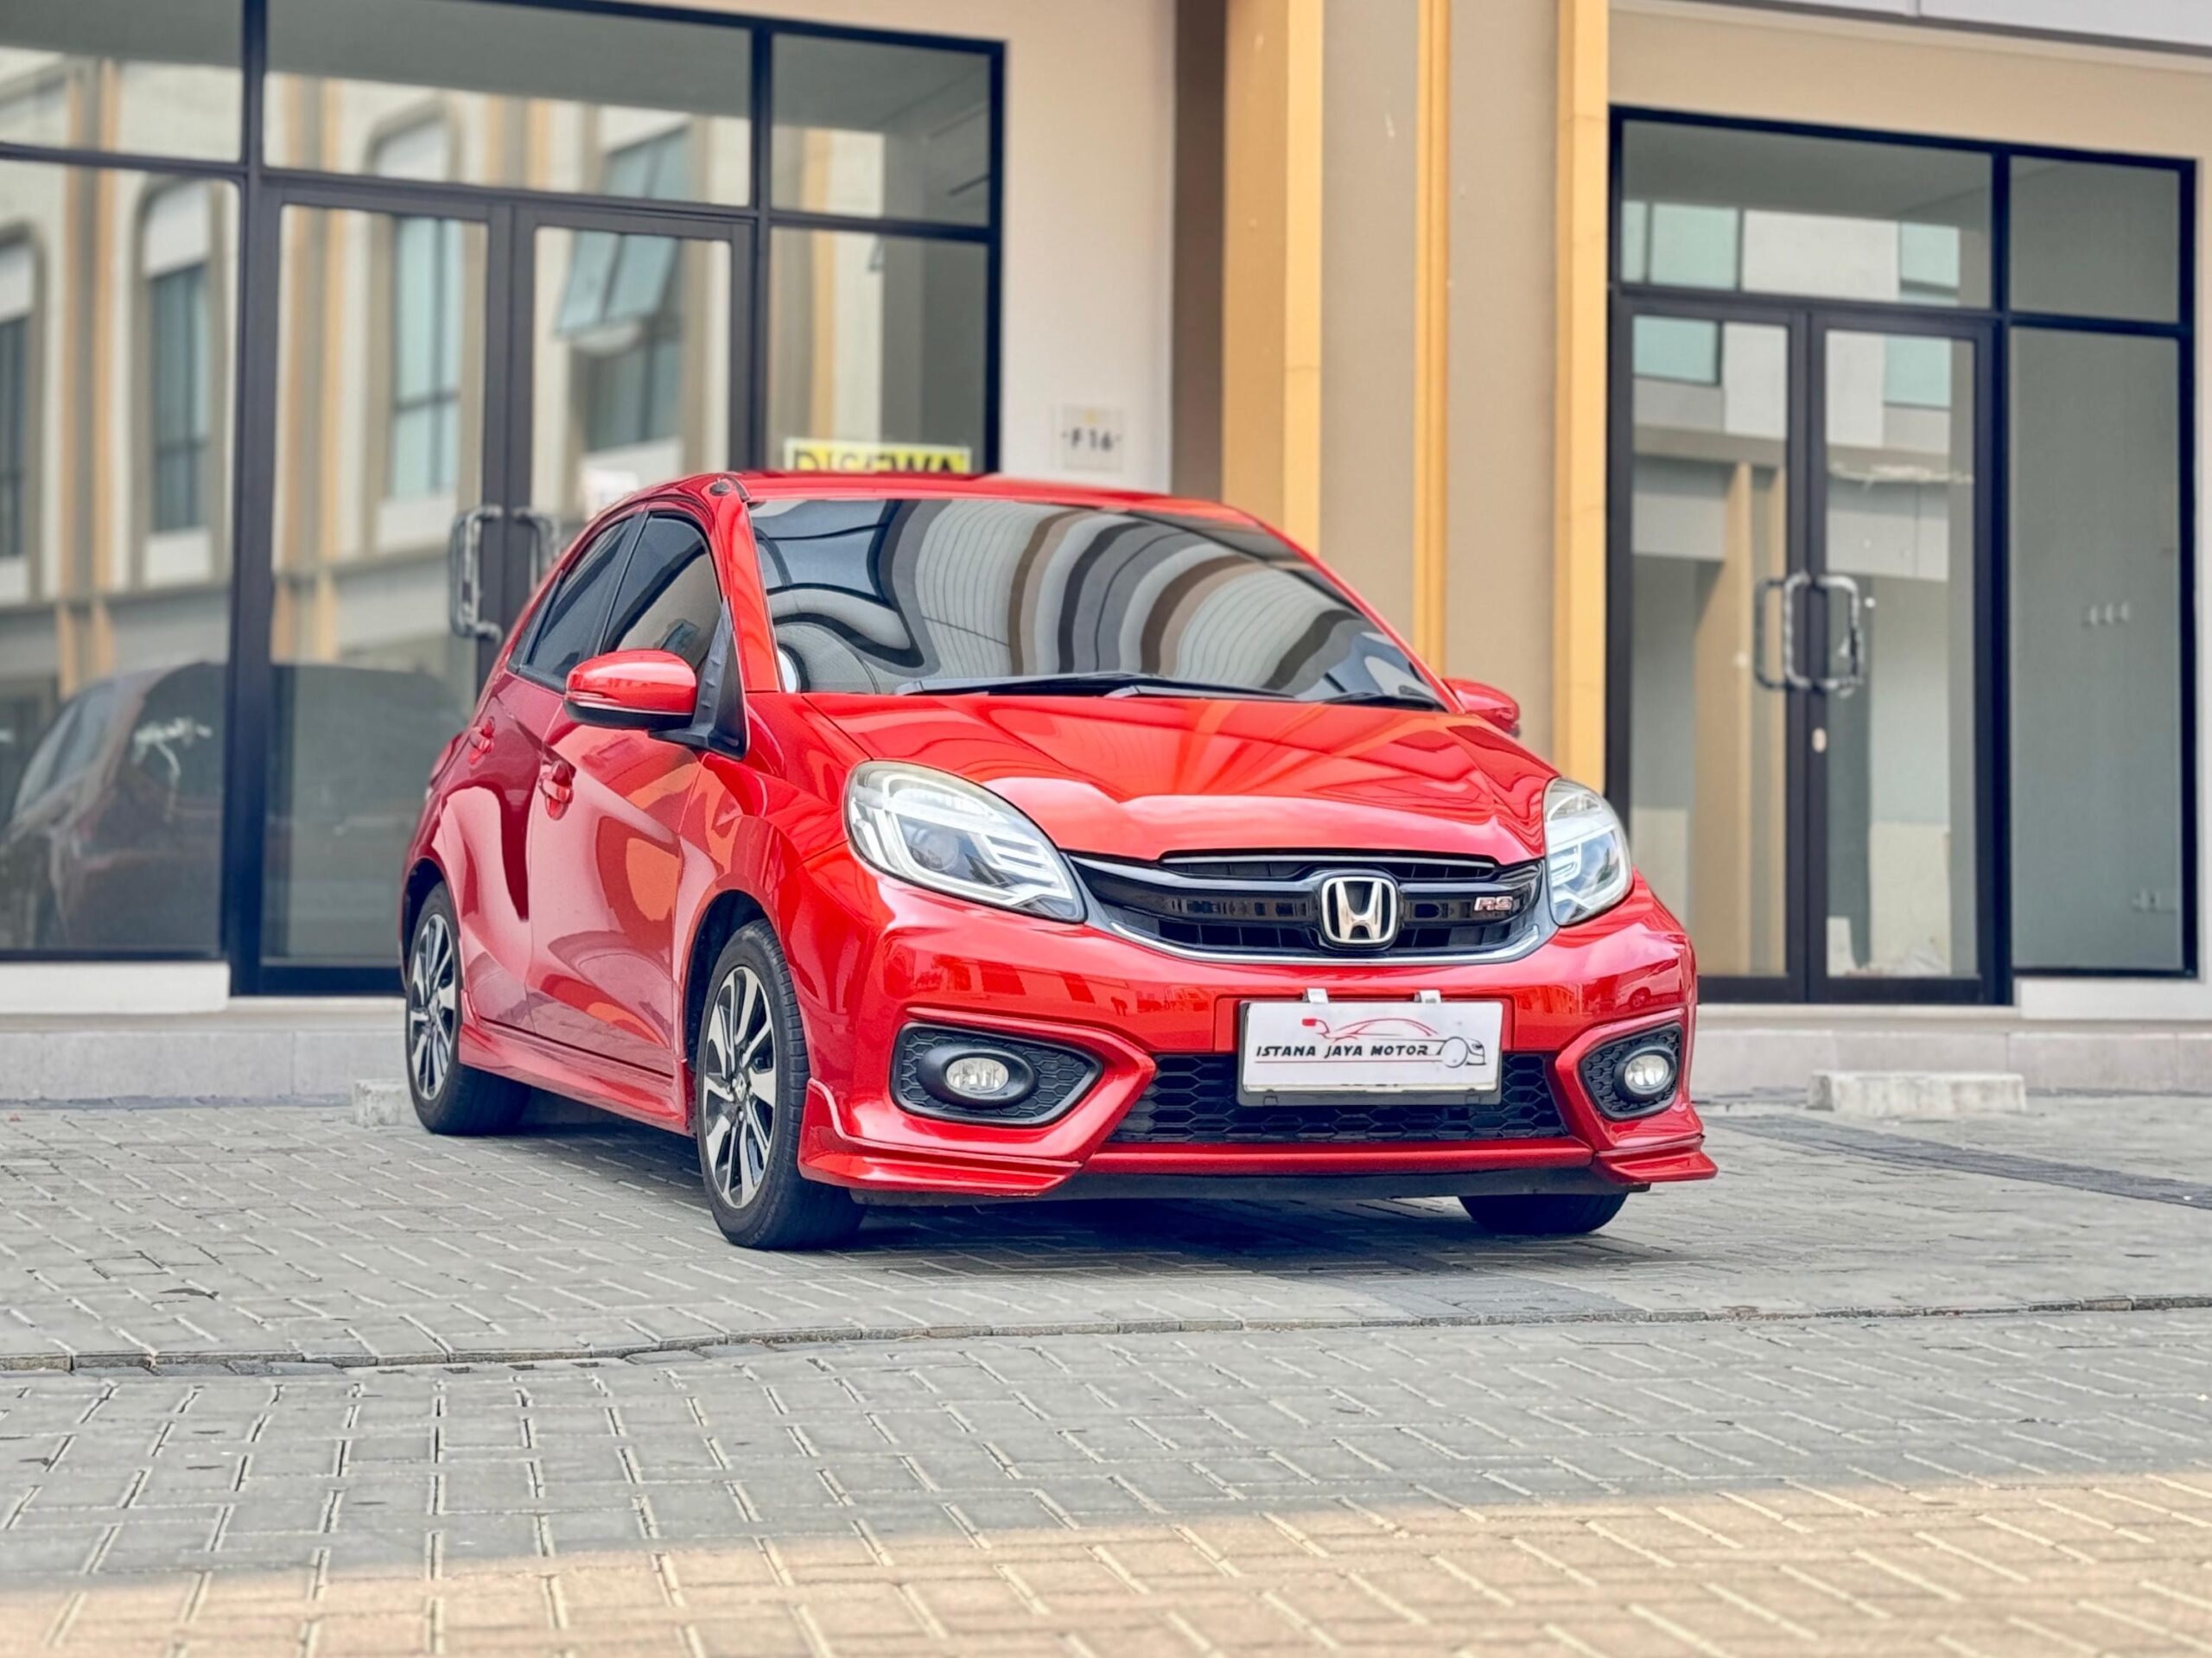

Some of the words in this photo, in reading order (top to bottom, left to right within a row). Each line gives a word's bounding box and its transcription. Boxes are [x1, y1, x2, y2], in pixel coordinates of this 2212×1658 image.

[1474, 896, 1513, 912] RS
[1255, 1045, 1316, 1057] ISTANA
[1324, 1045, 1363, 1059] JAYA
[1370, 1045, 1428, 1056] MOTOR
